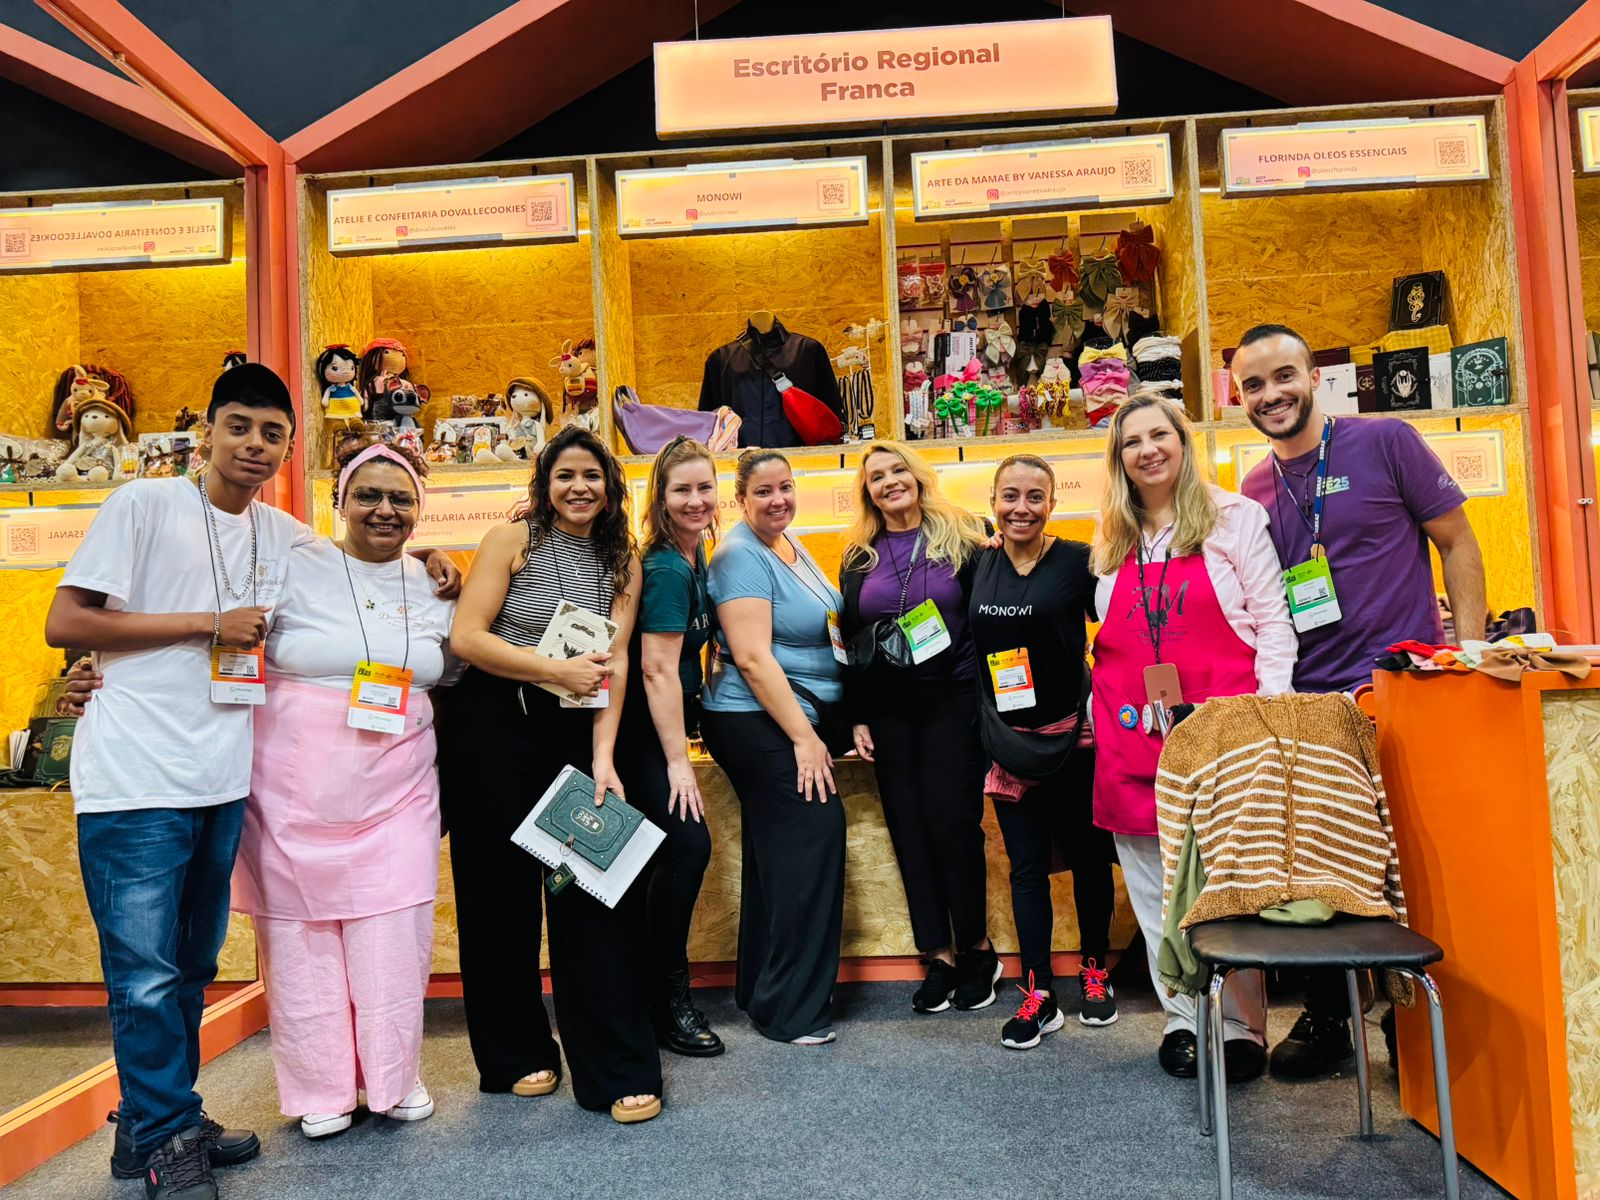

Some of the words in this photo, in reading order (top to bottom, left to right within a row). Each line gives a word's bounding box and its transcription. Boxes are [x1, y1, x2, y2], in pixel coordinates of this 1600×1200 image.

[733, 52, 869, 78] Escritório
[877, 43, 1000, 71] Regional
[821, 80, 915, 101] Franca
[1258, 152, 1311, 163] FLORINDA
[1313, 150, 1347, 160] OLEOS
[1349, 147, 1408, 158] ESSENCIAIS
[927, 177, 952, 188] ARTE
[954, 176, 969, 186] DA
[971, 173, 1010, 185] MAMAE
[1012, 172, 1025, 182] BY
[1027, 169, 1074, 181] VANESSA
[1076, 166, 1116, 178] ARAUJO
[696, 192, 742, 202] MONOWI
[333, 214, 365, 225] ATELIE
[367, 214, 373, 222] E
[375, 210, 438, 222] CONFEITARIA
[440, 204, 526, 218] DOVALLECOOKIES
[1056, 481, 1081, 490] LIMA
[419, 513, 465, 523] APELARIA
[978, 604, 1032, 617] MONOWI
